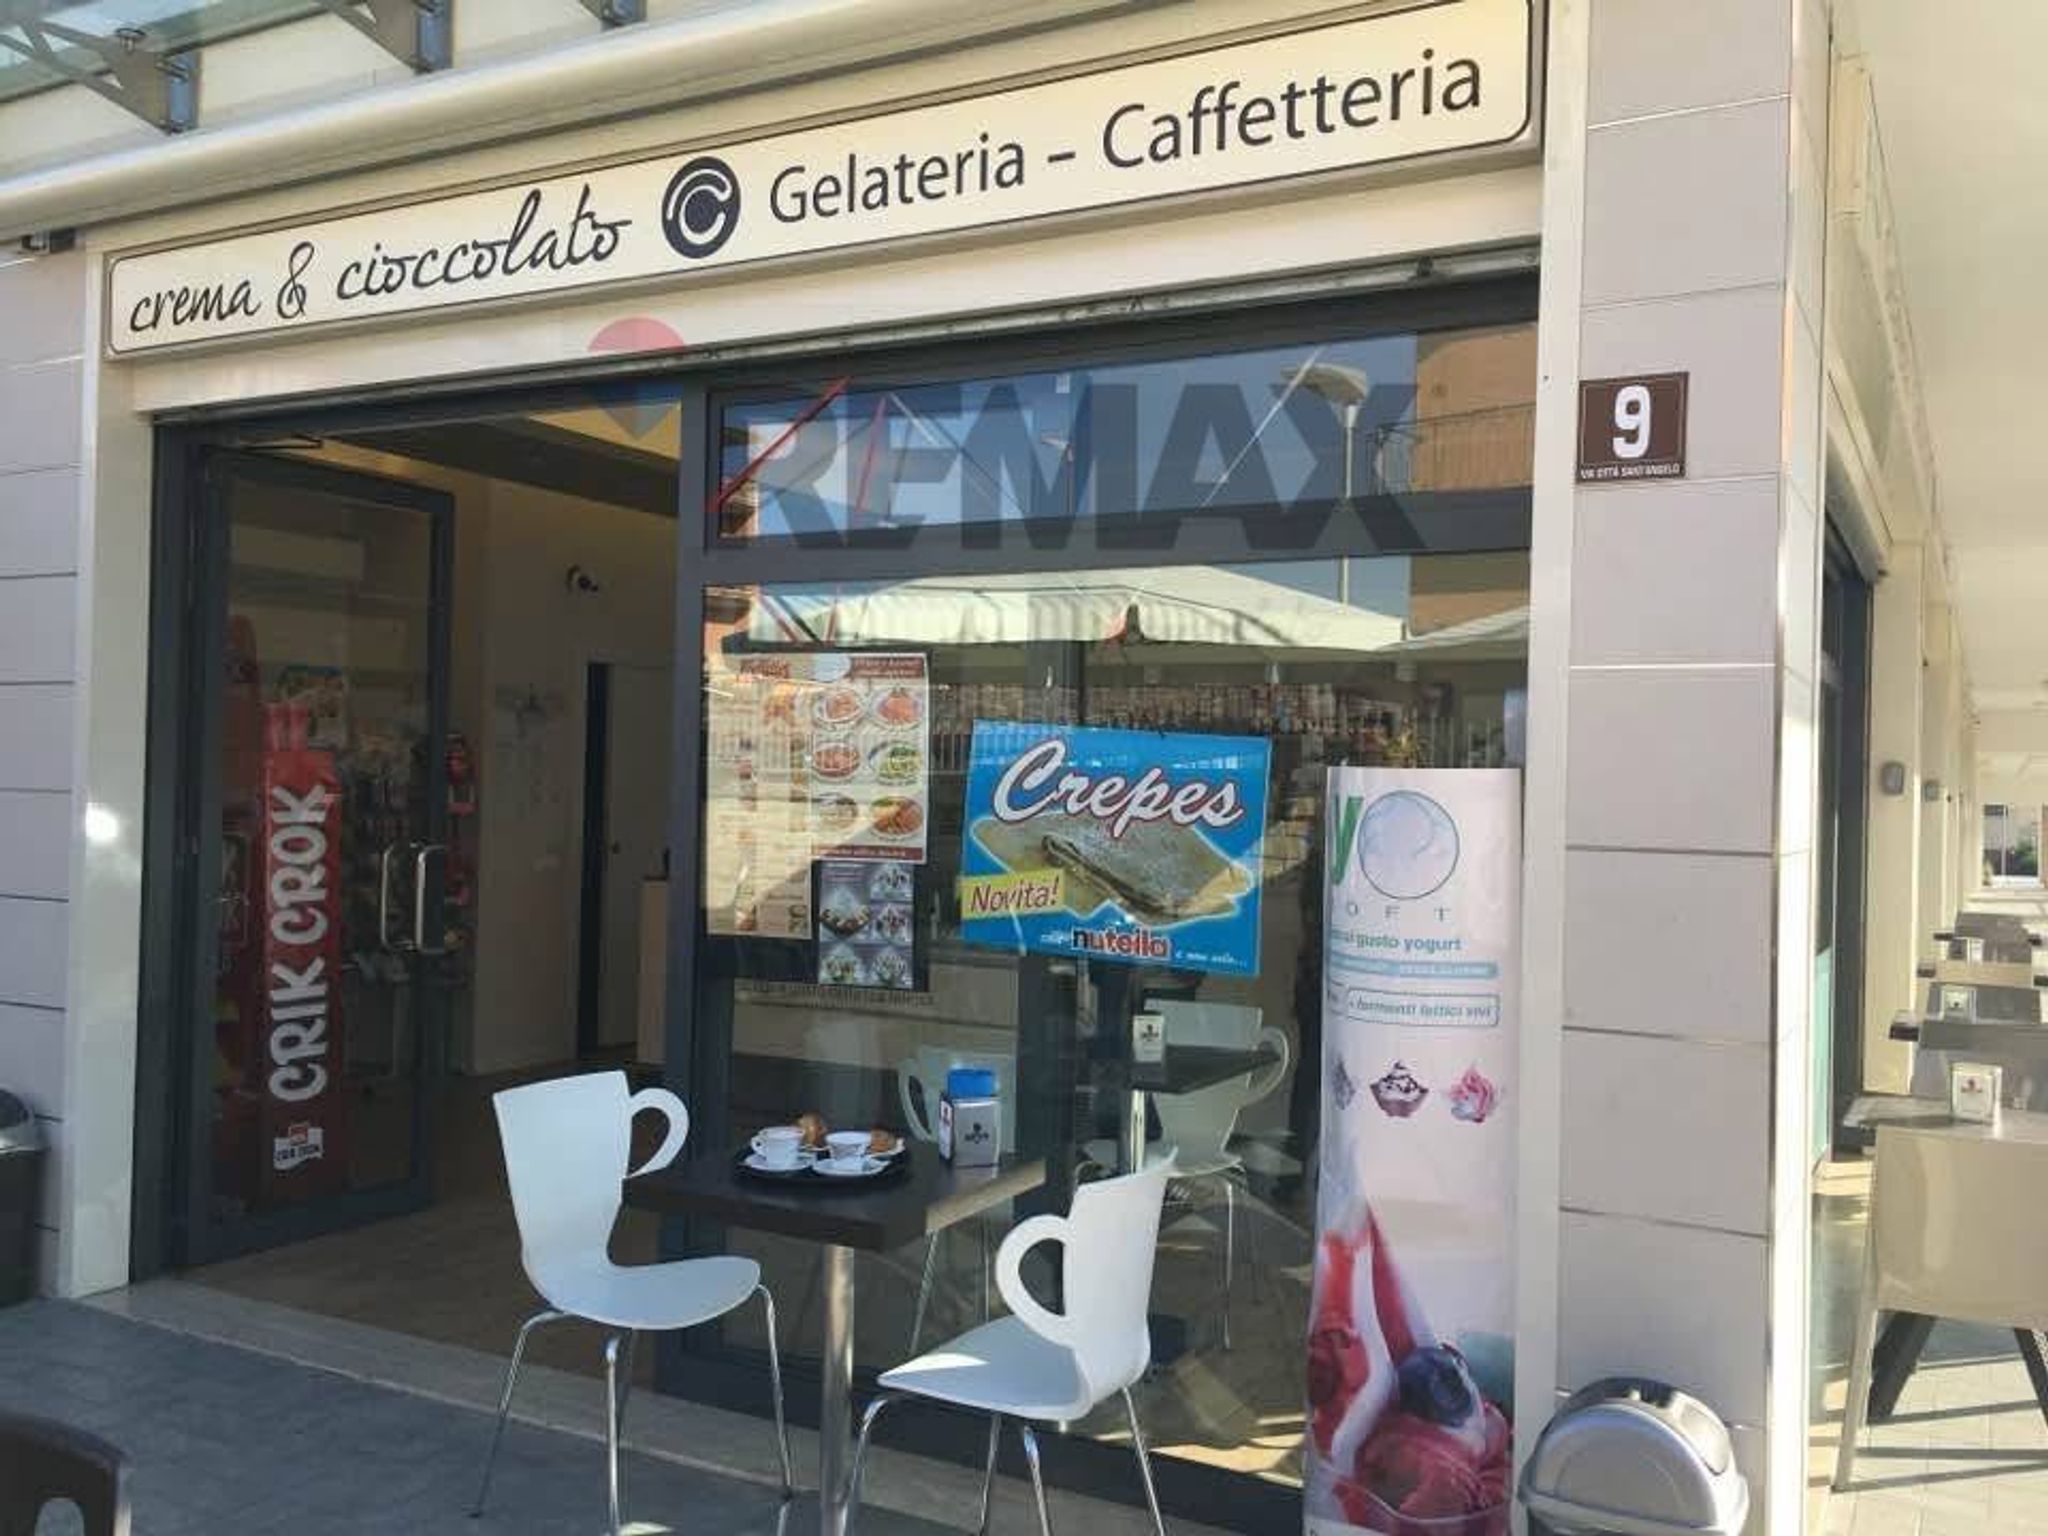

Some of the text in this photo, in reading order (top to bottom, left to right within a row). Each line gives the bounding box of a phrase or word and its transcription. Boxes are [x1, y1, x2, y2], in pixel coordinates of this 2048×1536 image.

[130, 278, 262, 332] crema
[276, 241, 315, 319] &
[337, 183, 633, 300] cioccolato
[769, 132, 1026, 223] Gelateria
[1102, 47, 1482, 170] Caffetteria
[1613, 384, 1651, 459] 9
[994, 740, 1244, 838] Crepes
[269, 784, 329, 945] CROK
[1073, 929, 1169, 958] nutella
[1357, 934, 1399, 949] gusto
[1403, 938, 1462, 954] yogurt
[268, 956, 328, 1102] CRIK
